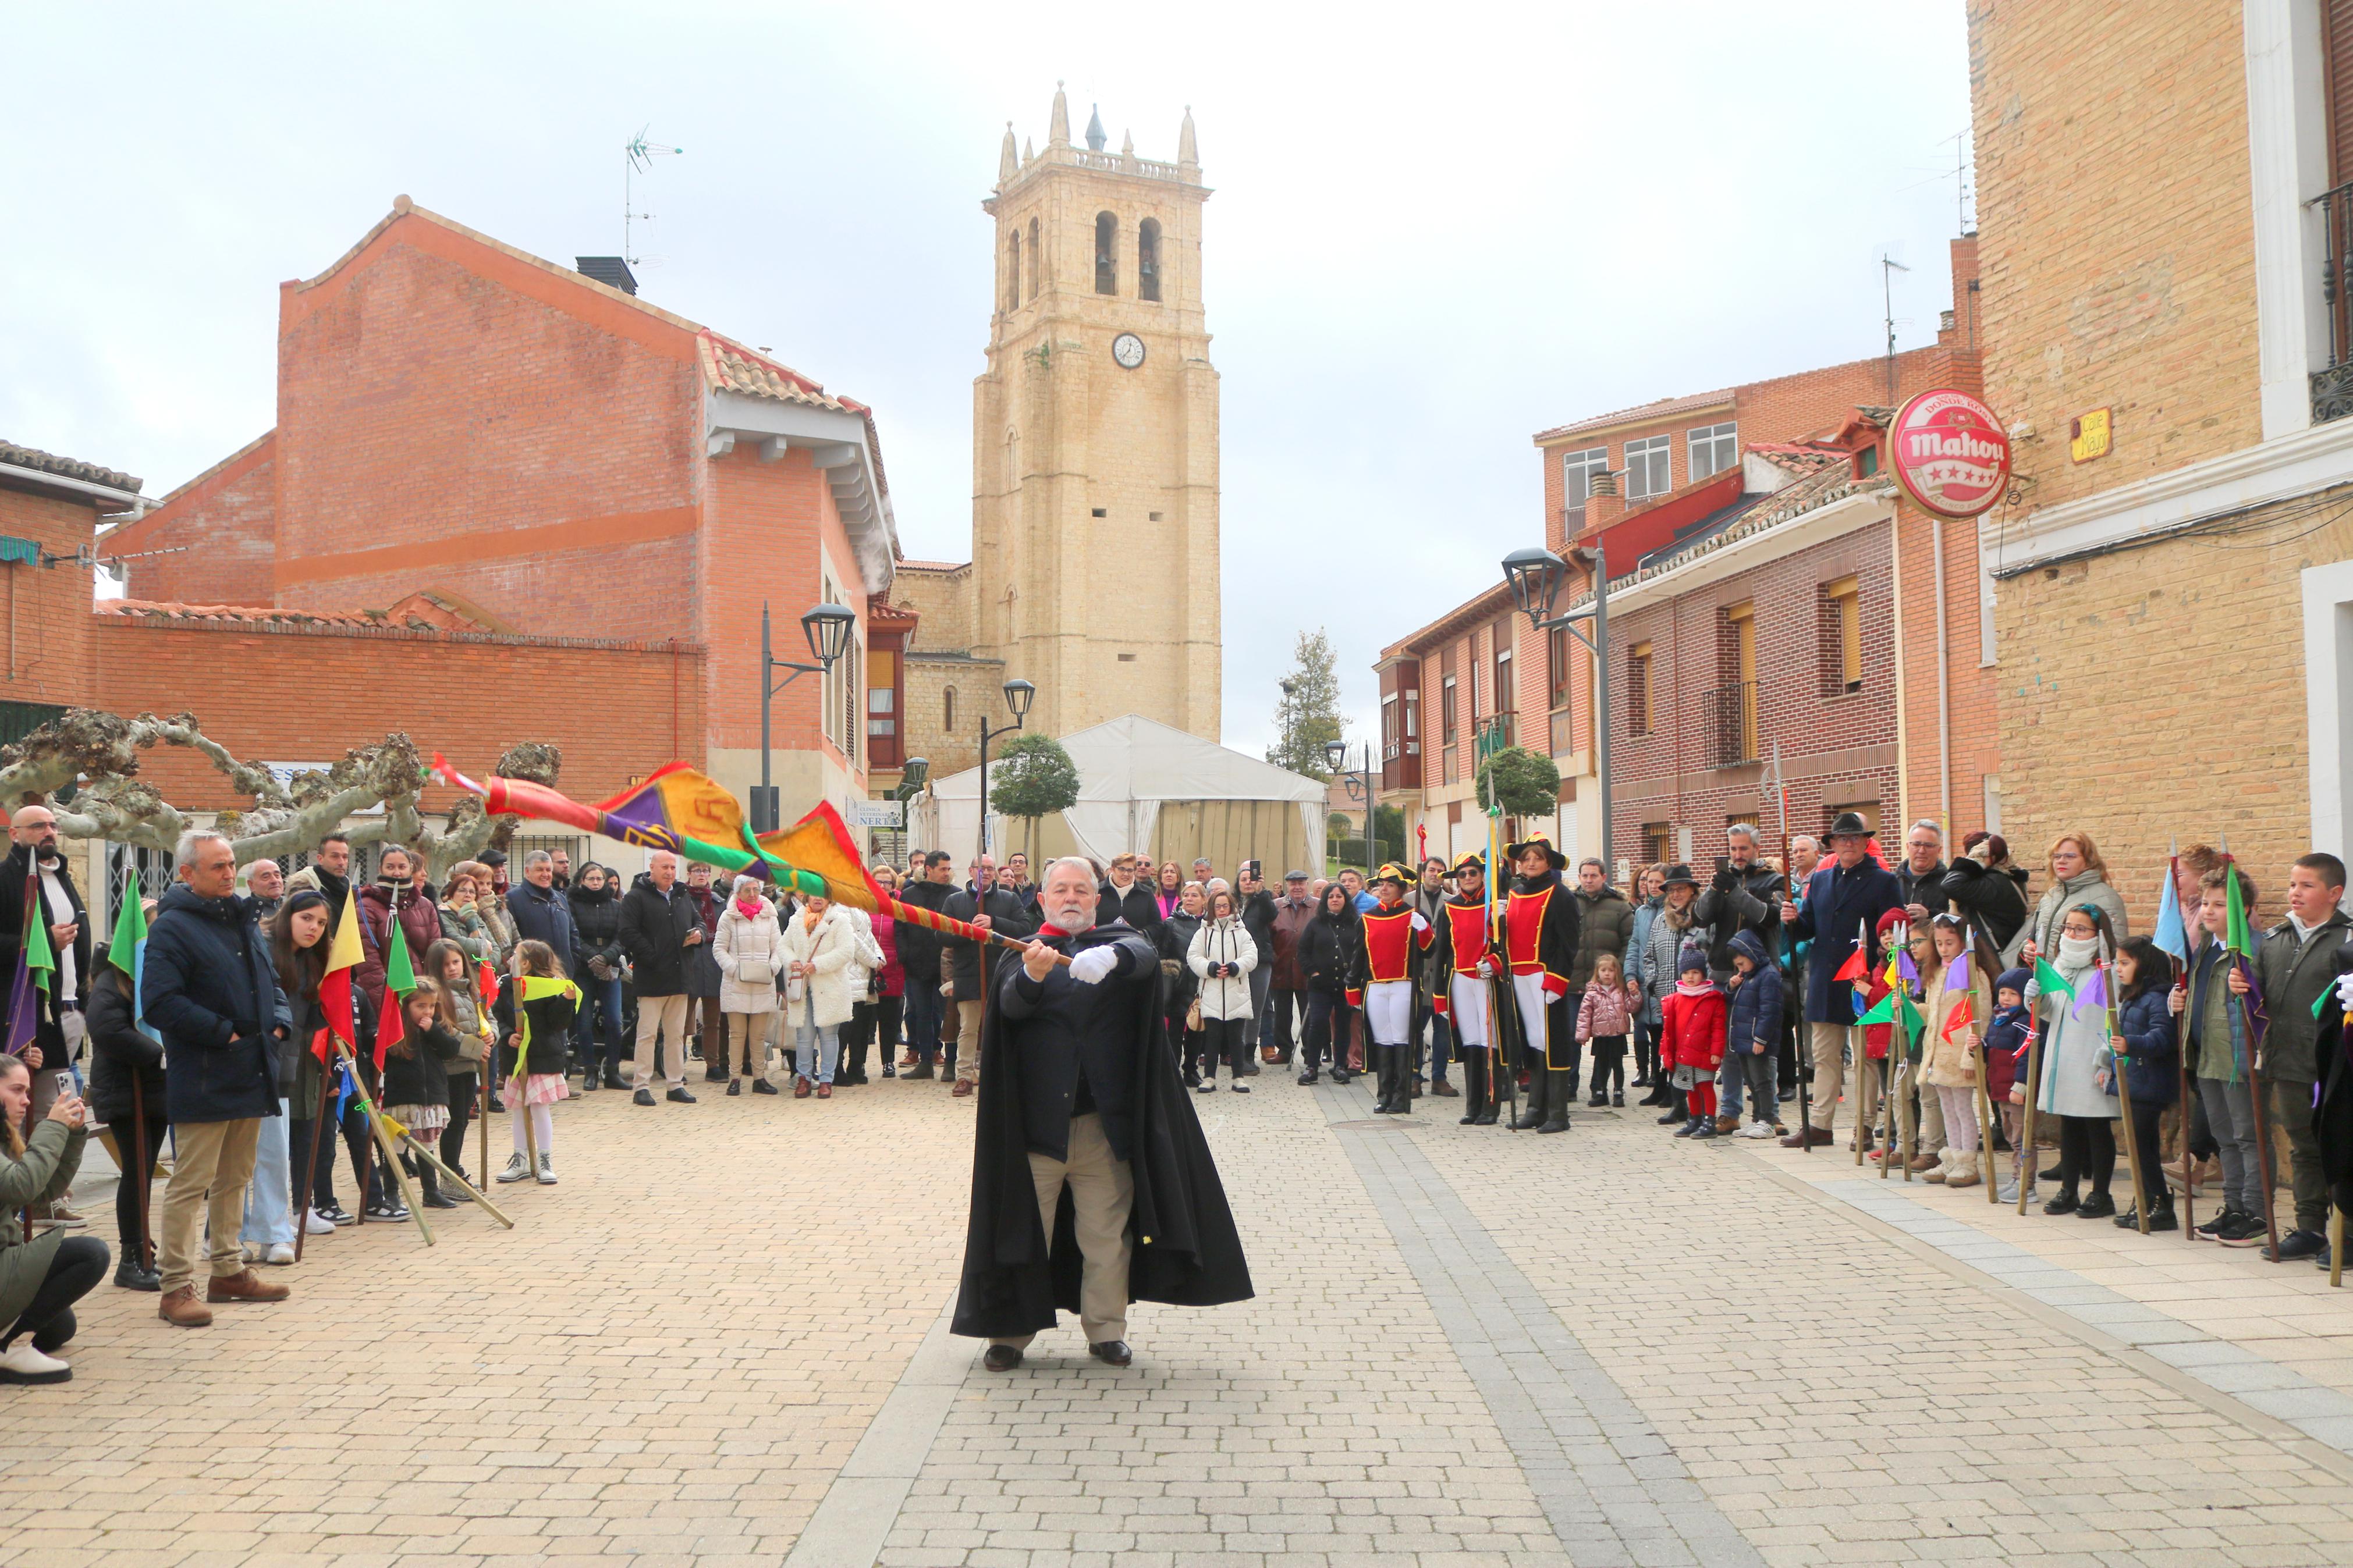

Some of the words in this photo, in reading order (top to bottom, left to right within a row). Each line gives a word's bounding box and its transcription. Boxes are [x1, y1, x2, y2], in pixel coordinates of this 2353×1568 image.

[1925, 398, 1964, 414] DONDE
[2083, 414, 2103, 432] Calle
[1909, 431, 2005, 461] Mahou
[2082, 432, 2108, 456] Mayor
[1940, 499, 1965, 510] CINCO
